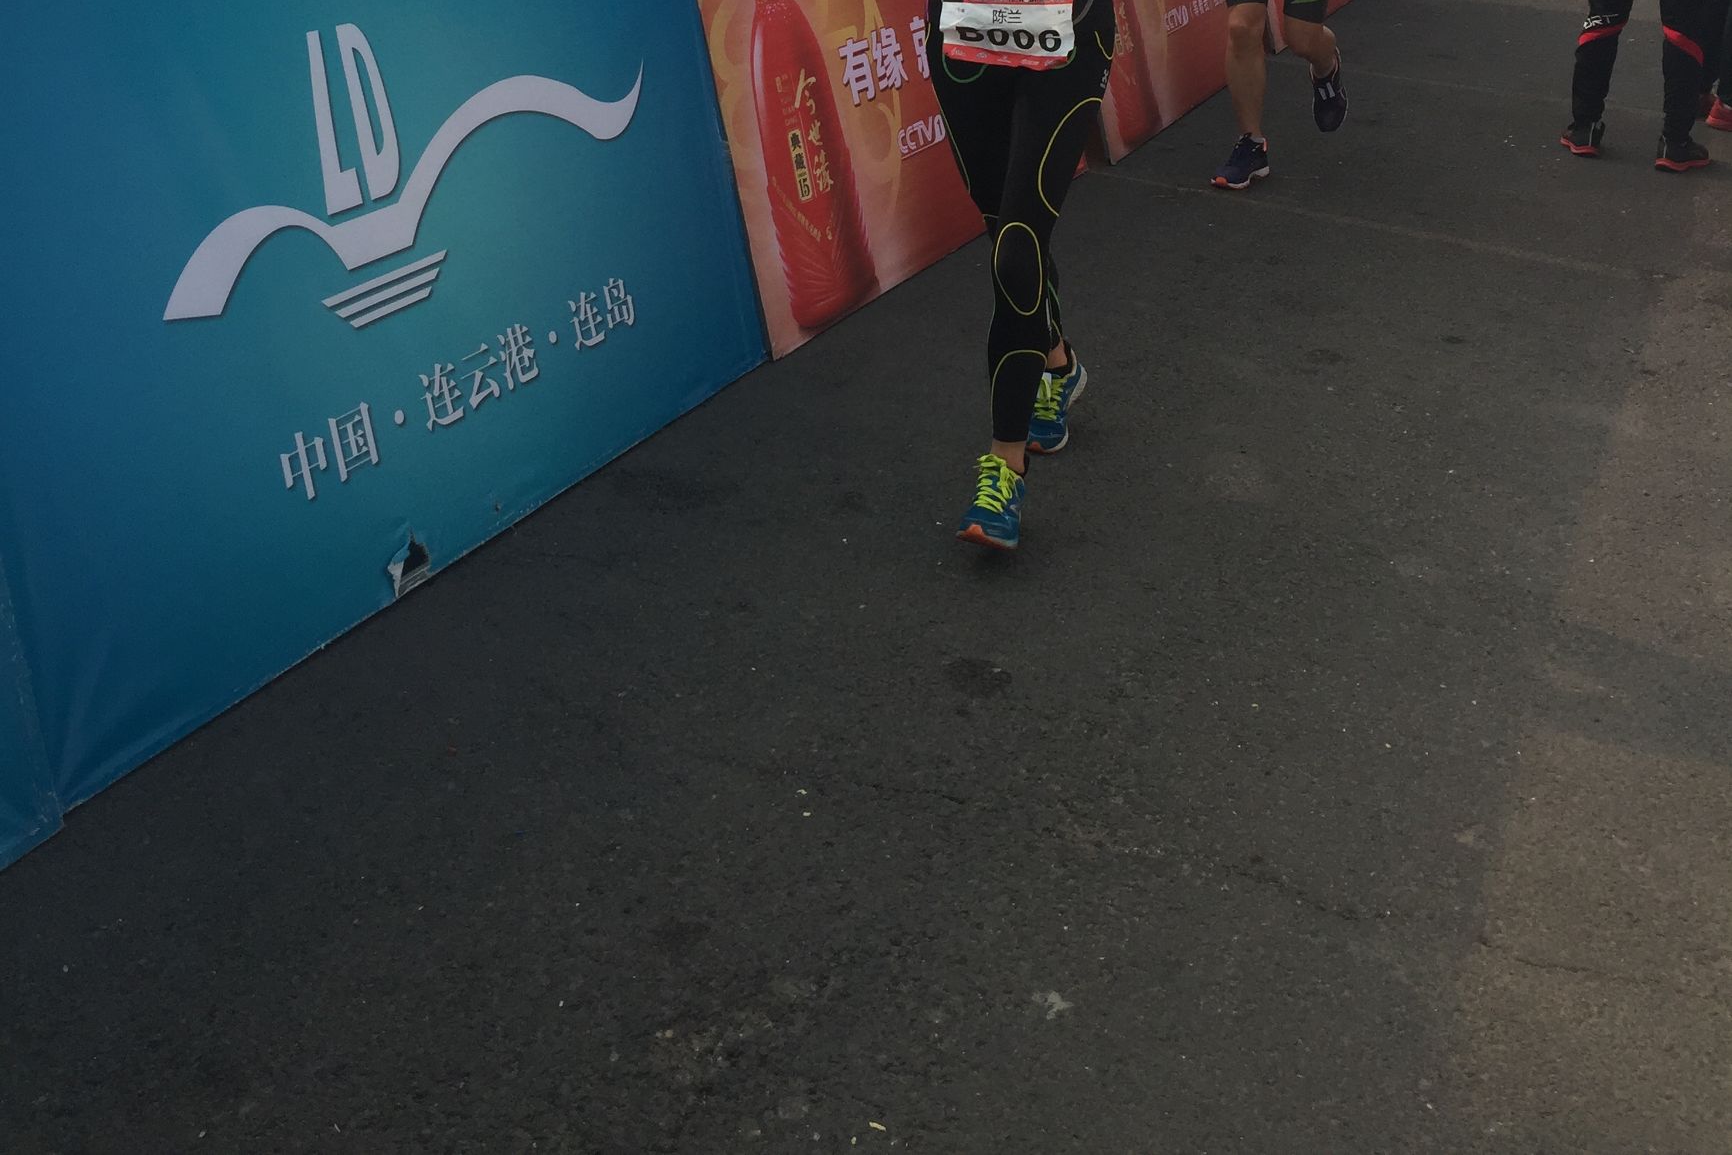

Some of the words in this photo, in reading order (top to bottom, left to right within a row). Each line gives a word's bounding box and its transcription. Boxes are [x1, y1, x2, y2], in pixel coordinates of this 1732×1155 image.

[992, 8, 1023, 25] 陈兰
[838, 27, 909, 106] 有缘
[306, 22, 400, 216] LD
